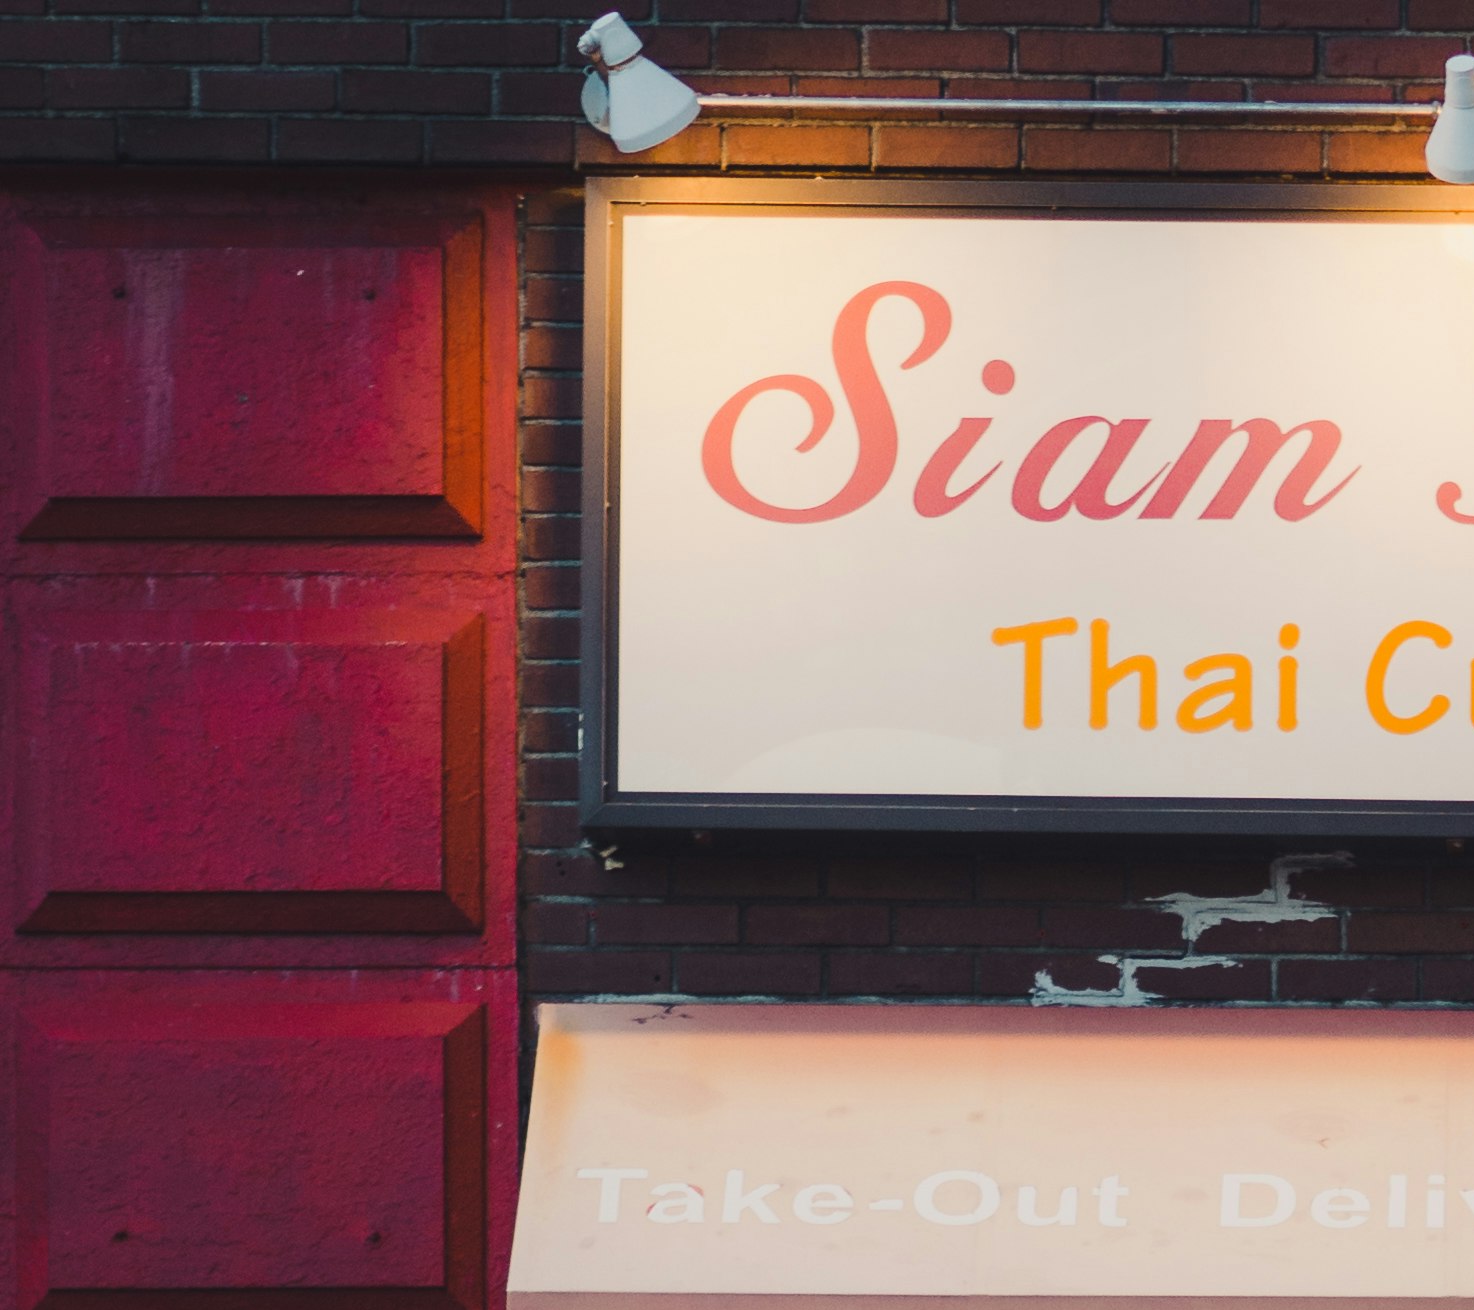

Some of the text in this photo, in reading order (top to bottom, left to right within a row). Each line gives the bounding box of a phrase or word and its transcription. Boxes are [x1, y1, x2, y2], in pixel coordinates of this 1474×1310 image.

[700, 280, 1362, 524] Siam
[991, 617, 1301, 733] Thai
[577, 1167, 1130, 1228] Take-Out
